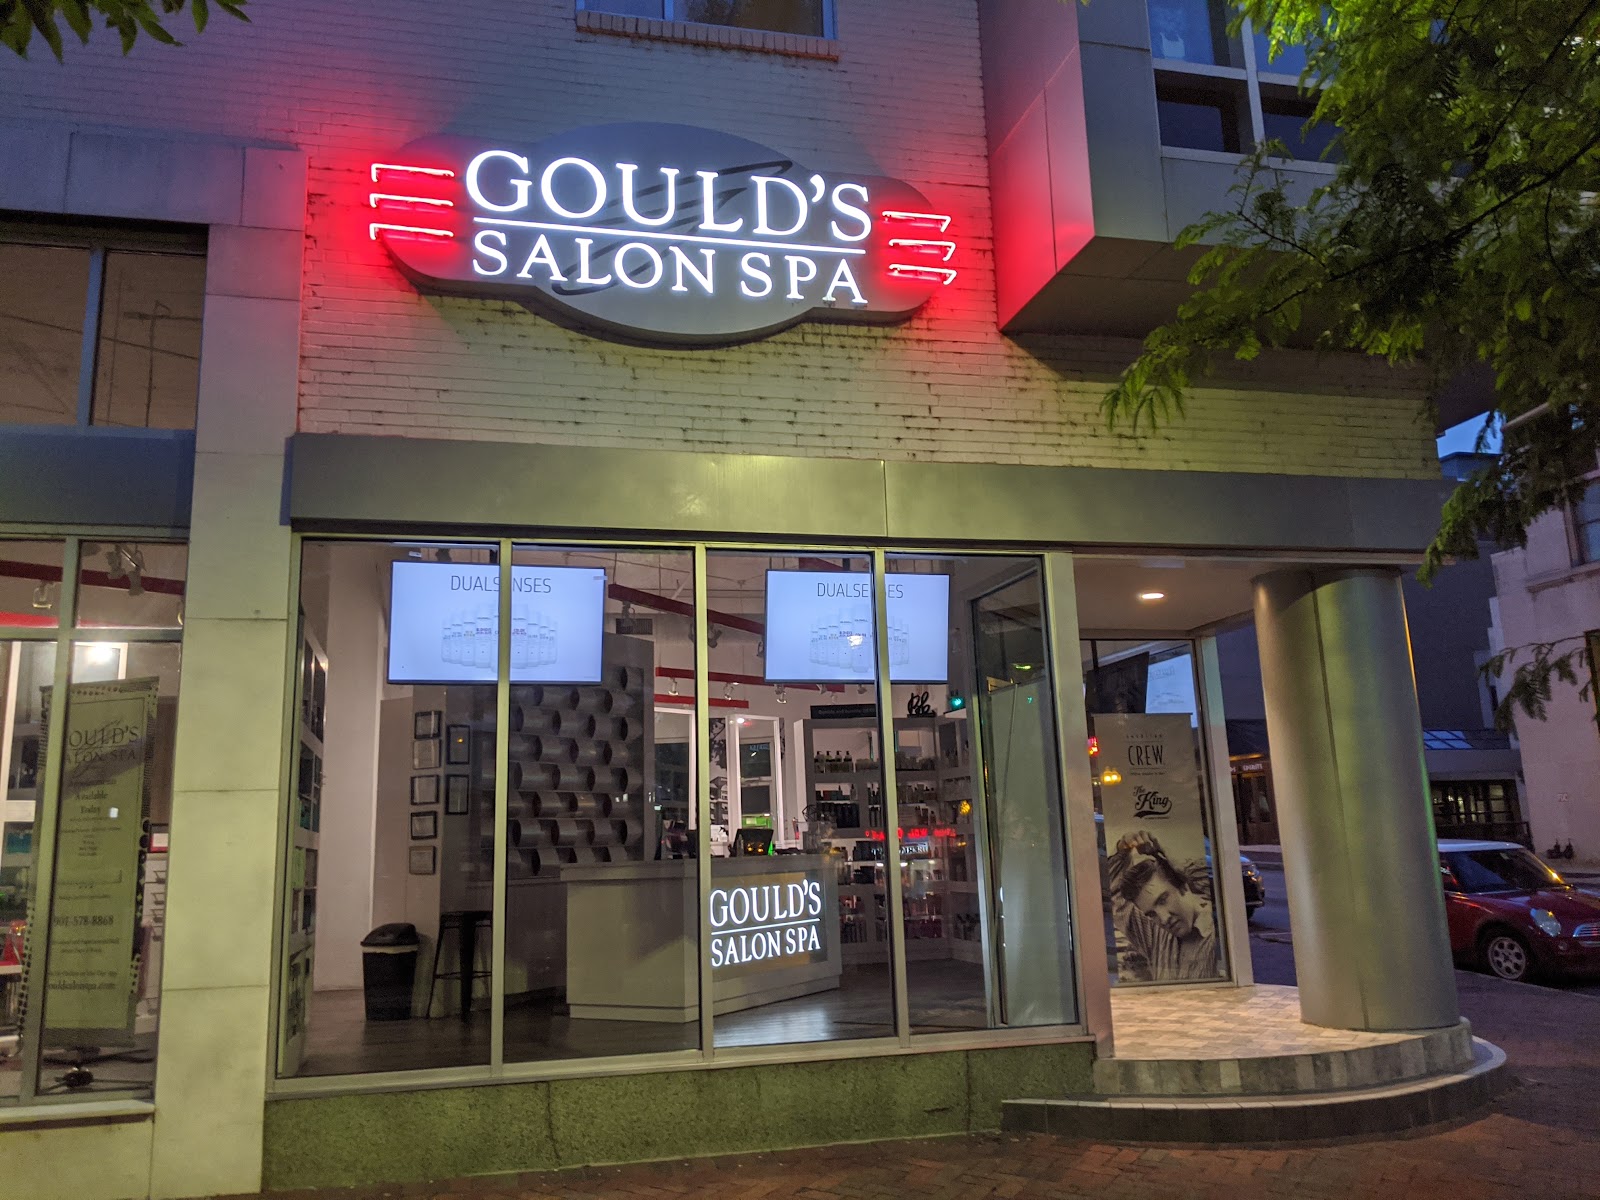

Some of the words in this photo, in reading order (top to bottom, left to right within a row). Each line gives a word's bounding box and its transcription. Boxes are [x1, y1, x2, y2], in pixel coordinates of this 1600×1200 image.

[465, 149, 873, 243] GOULD'S
[471, 229, 717, 294] SALON
[740, 252, 869, 304] SPA
[450, 574, 552, 594] DUALSNSES
[816, 582, 904, 599] DUALSEES
[68, 725, 140, 749] OULD'S
[65, 750, 104, 765] ALON
[112, 748, 137, 762] SPA
[1128, 744, 1164, 766] CREW
[1134, 791, 1172, 815] King
[709, 879, 822, 927] GOULD'S
[711, 930, 781, 968] SALON
[785, 924, 821, 955] SPA
